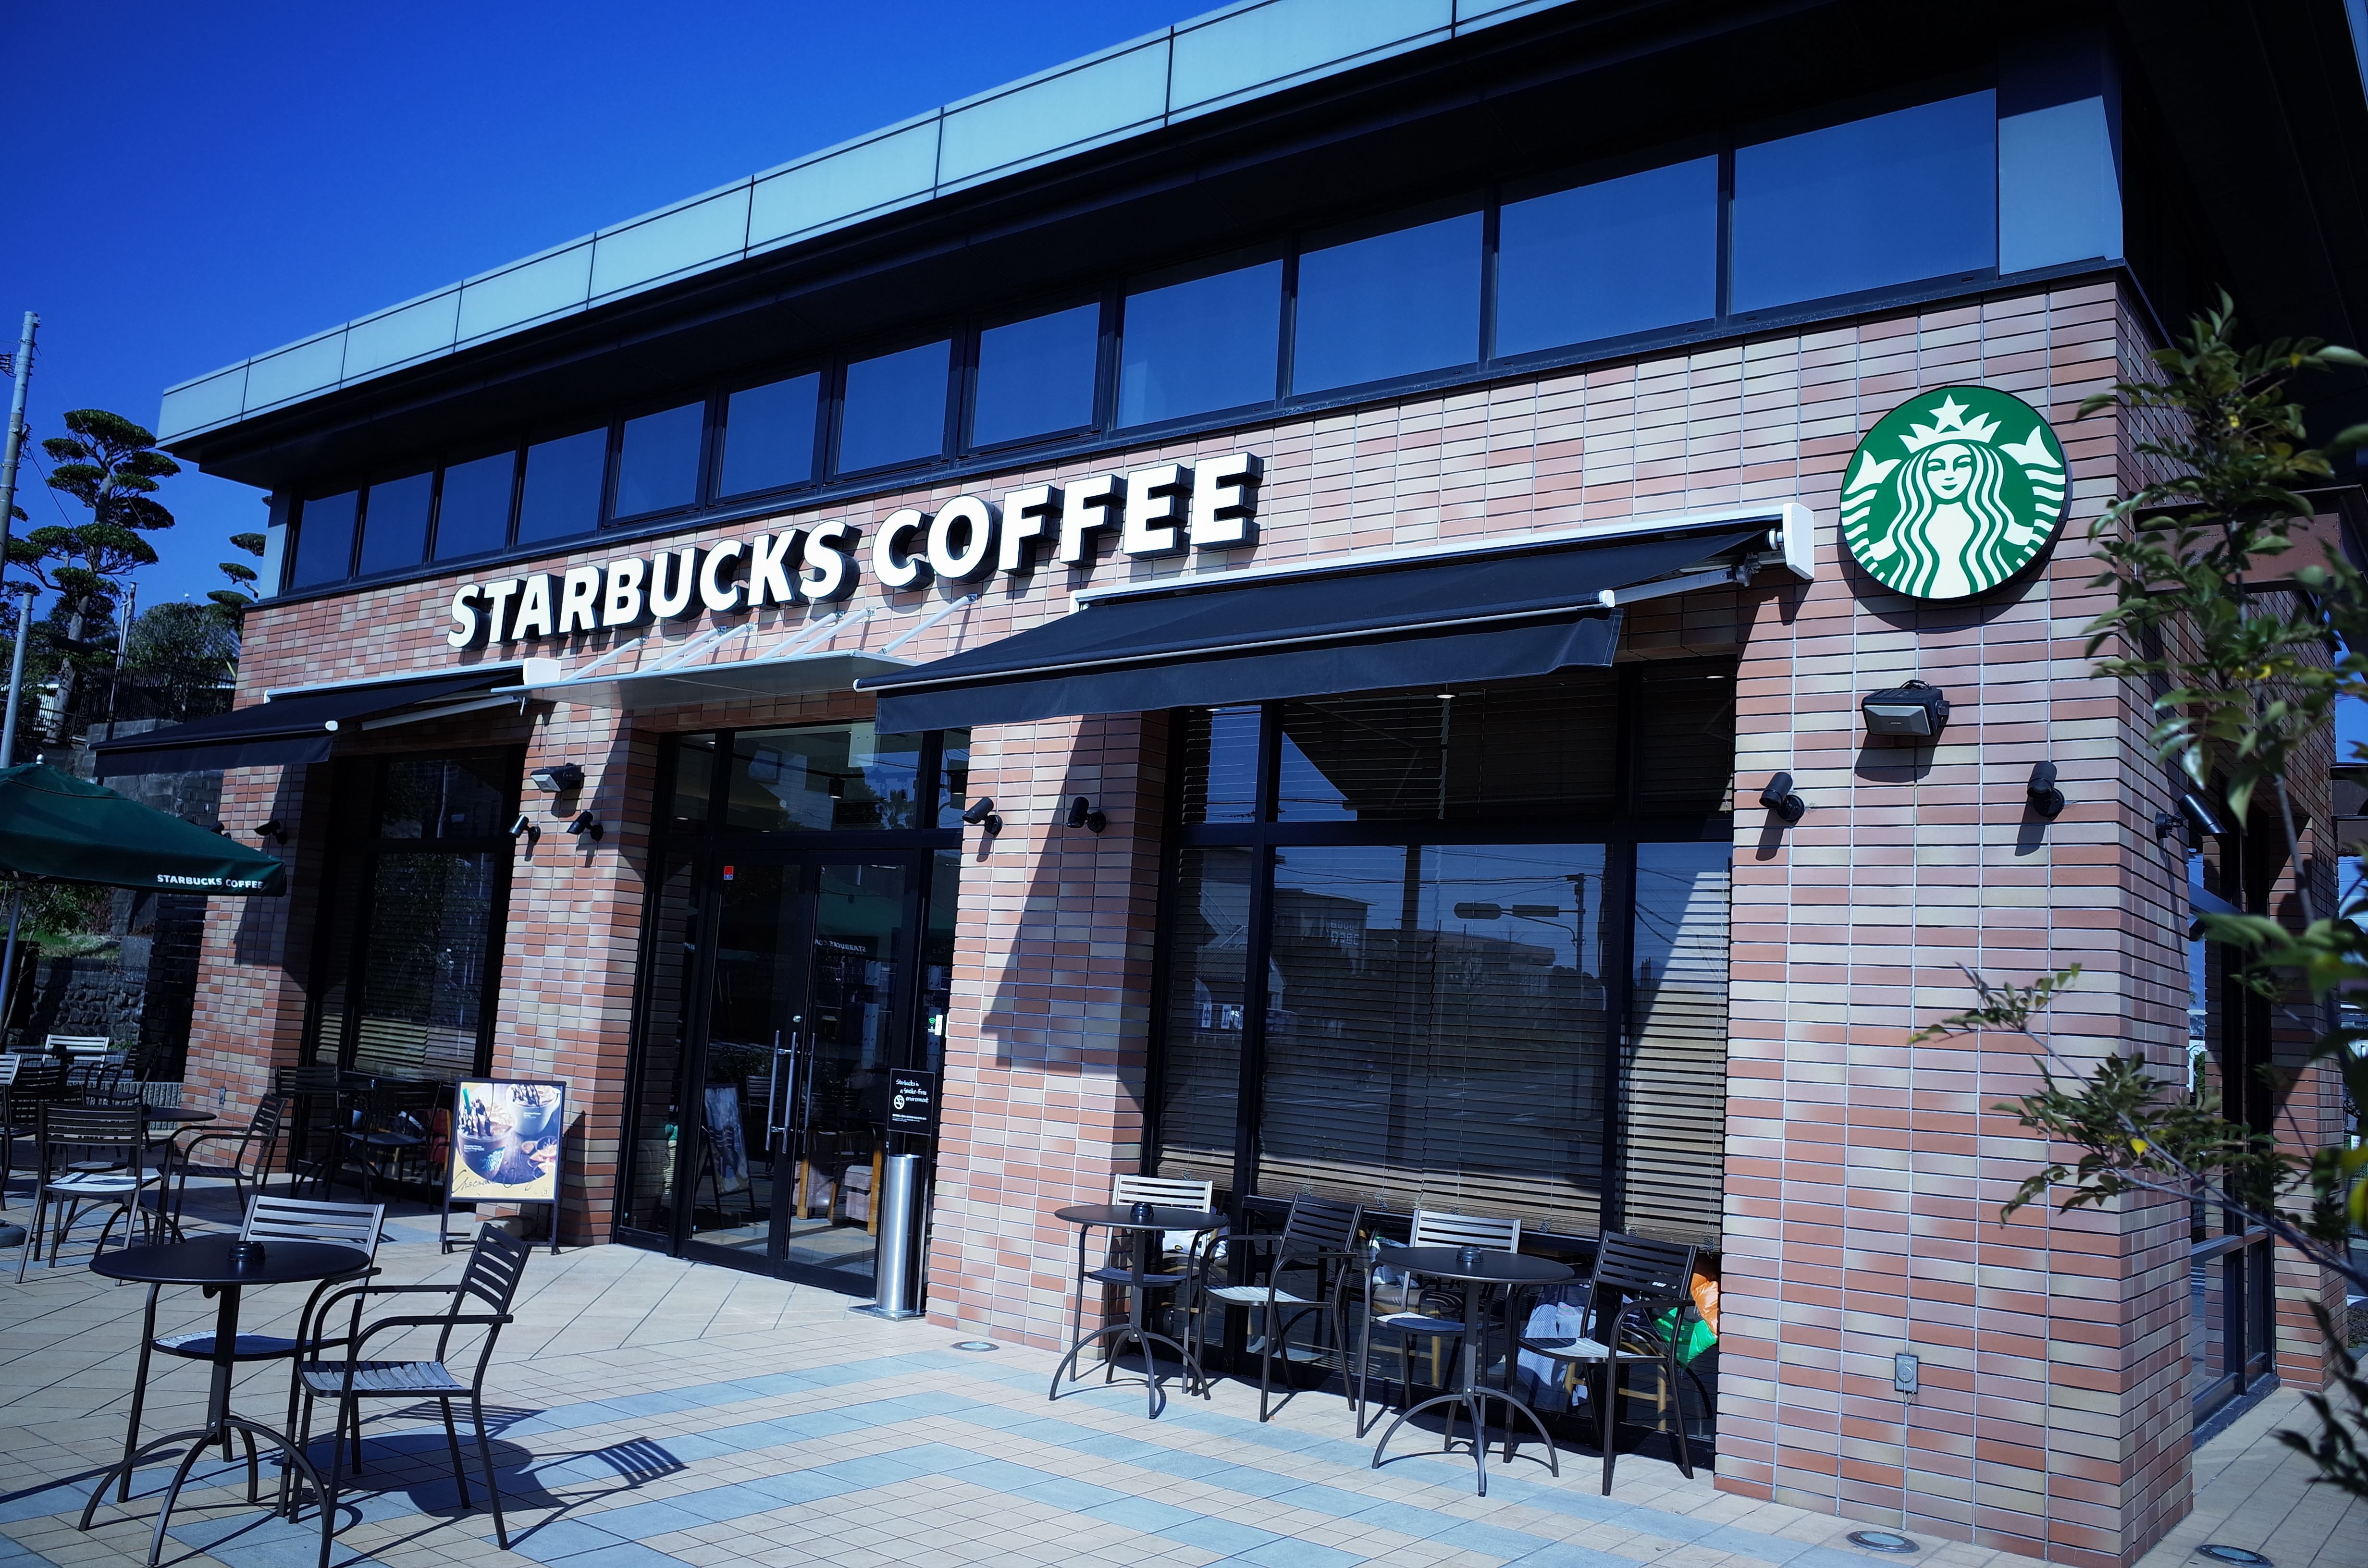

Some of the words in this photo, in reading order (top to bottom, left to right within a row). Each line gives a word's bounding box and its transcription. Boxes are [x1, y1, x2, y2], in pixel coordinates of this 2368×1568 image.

[447, 520, 850, 649] STARBUCKS
[872, 452, 1252, 588] COFFEE
[157, 874, 222, 886] STARBUCKS
[225, 879, 263, 889] COFFEE
